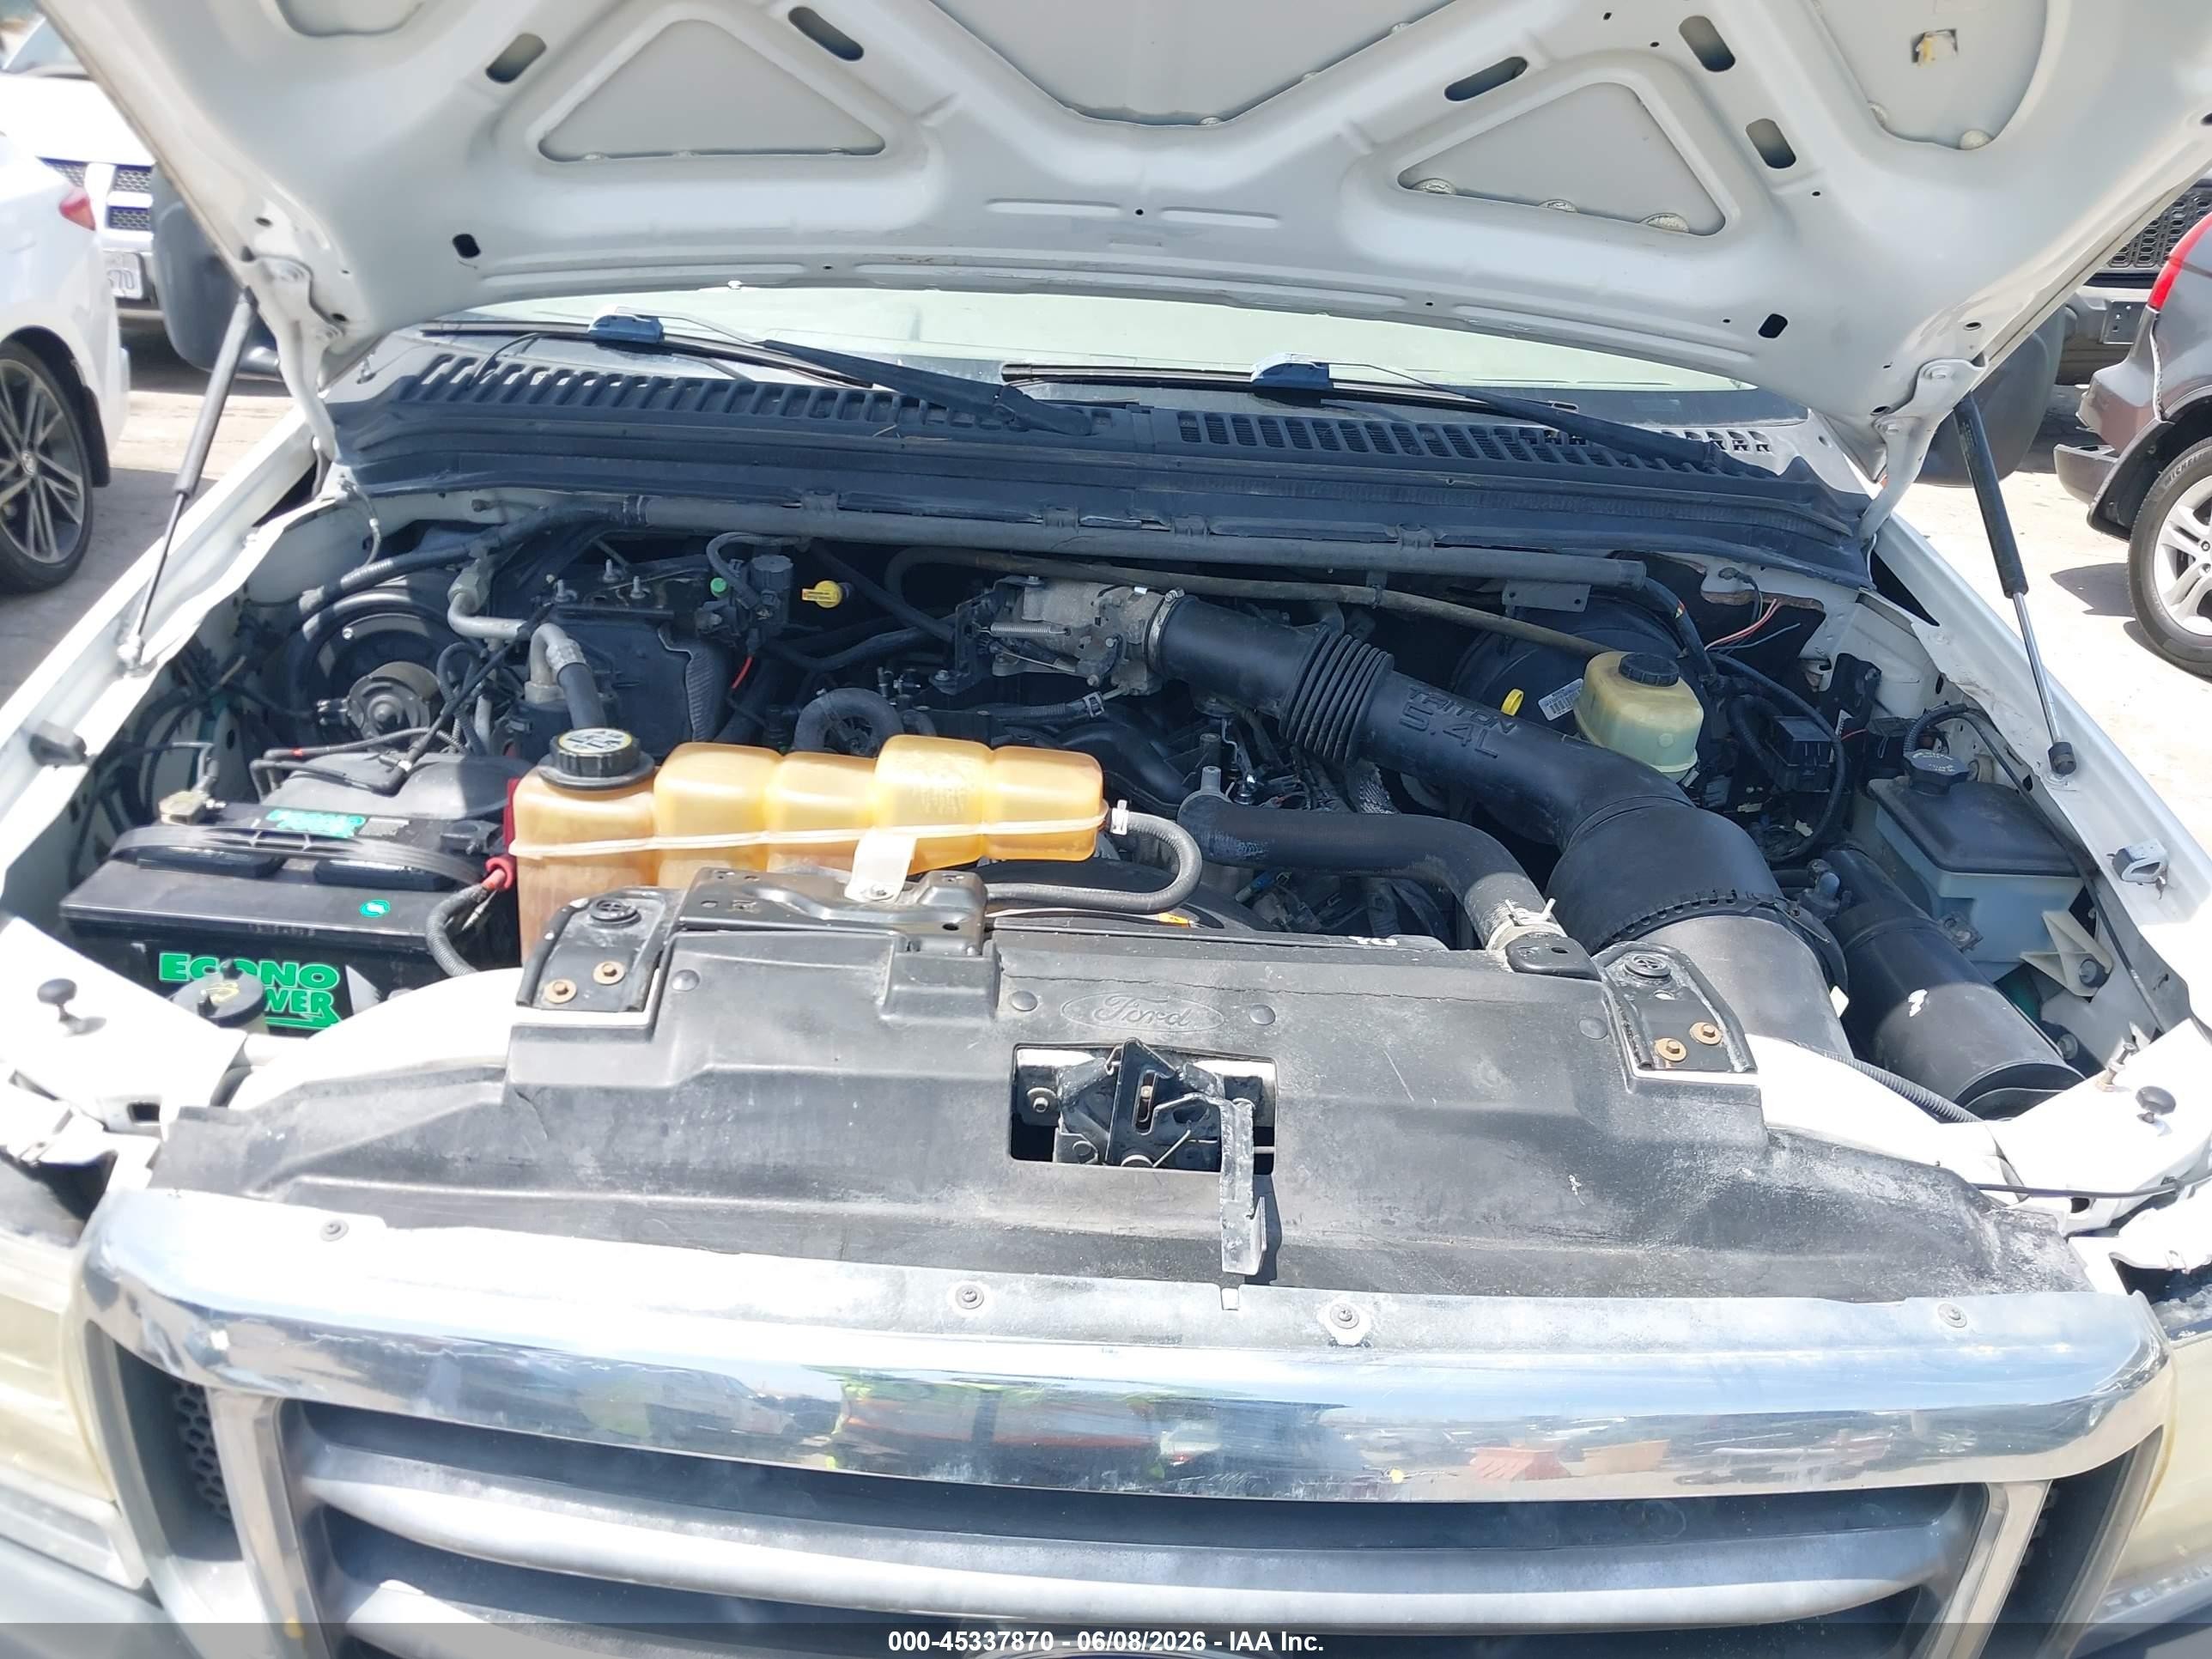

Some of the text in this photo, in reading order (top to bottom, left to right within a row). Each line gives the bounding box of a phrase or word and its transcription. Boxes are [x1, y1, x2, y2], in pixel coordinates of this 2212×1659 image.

[1398, 701, 1499, 760] 5.4L
[1407, 686, 1518, 735] TRITON
[1091, 994, 1193, 1028] Ford
